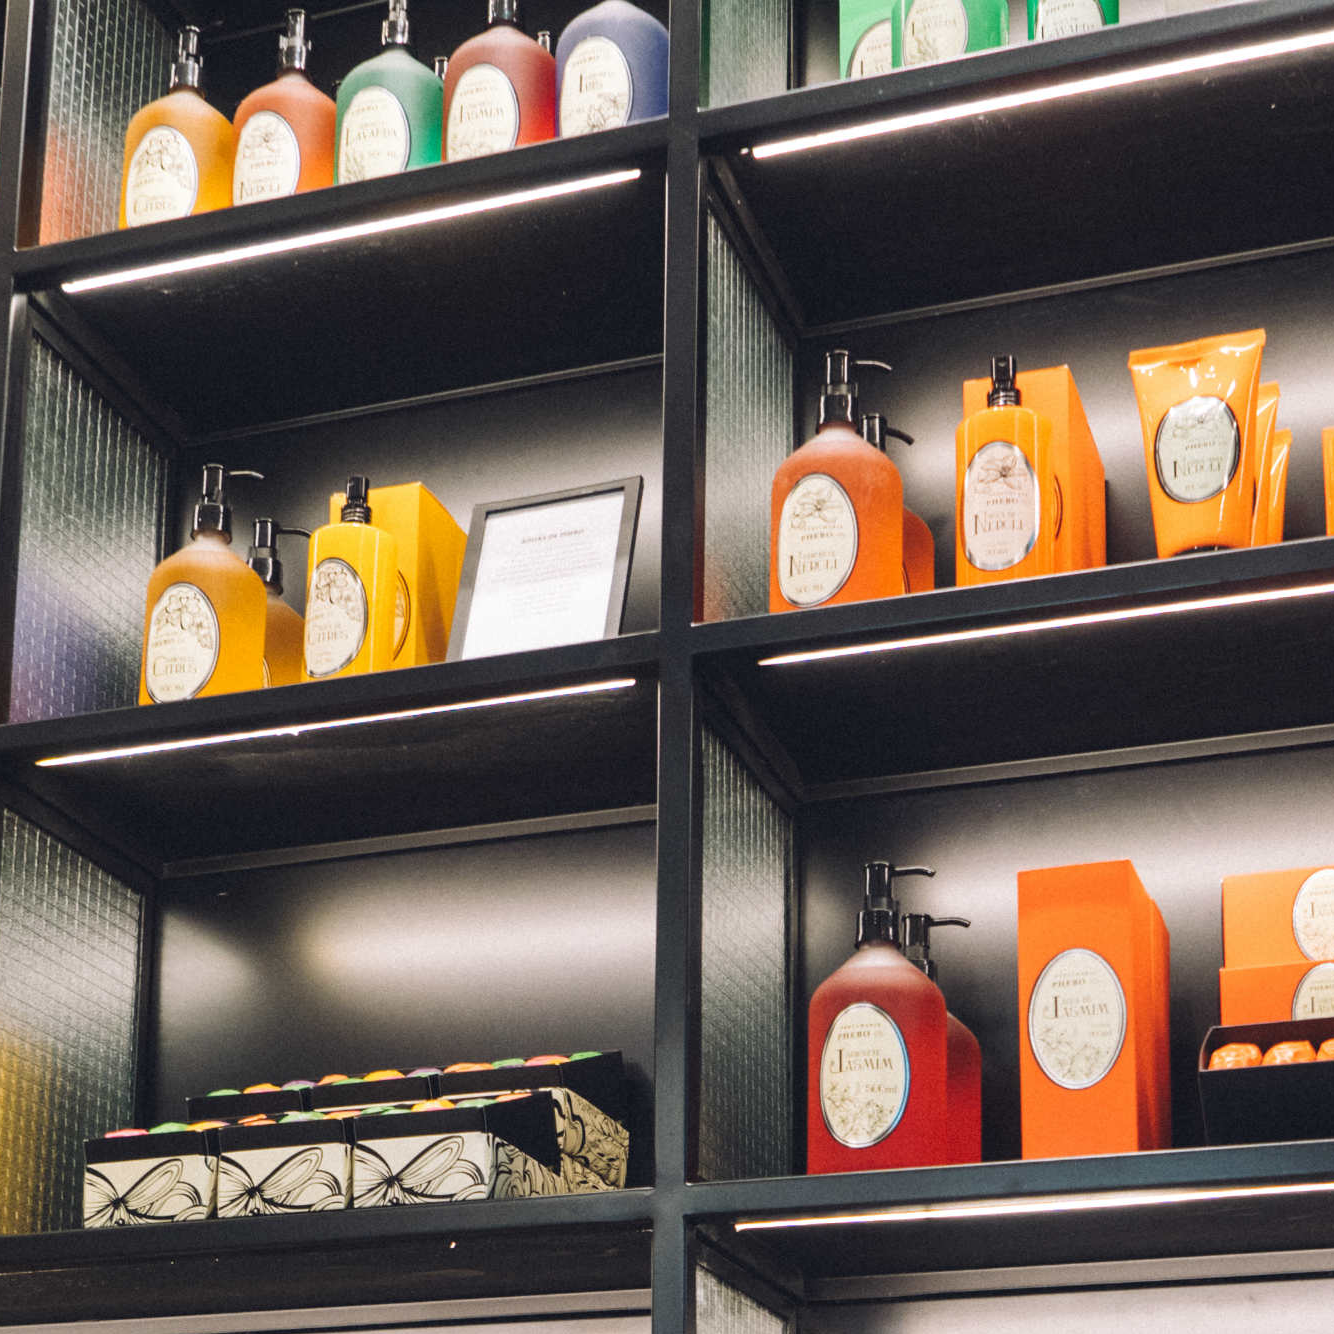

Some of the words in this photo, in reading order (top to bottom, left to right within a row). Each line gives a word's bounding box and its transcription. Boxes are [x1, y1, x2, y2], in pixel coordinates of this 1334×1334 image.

[1172, 459, 1224, 480] NEROLI
[973, 513, 1025, 536] NEROLI
[788, 554, 840, 577] NEROLI
[152, 655, 198, 678] CITRUS
[1042, 994, 1110, 1020] JASMIM
[829, 1047, 895, 1074] JASMIM
